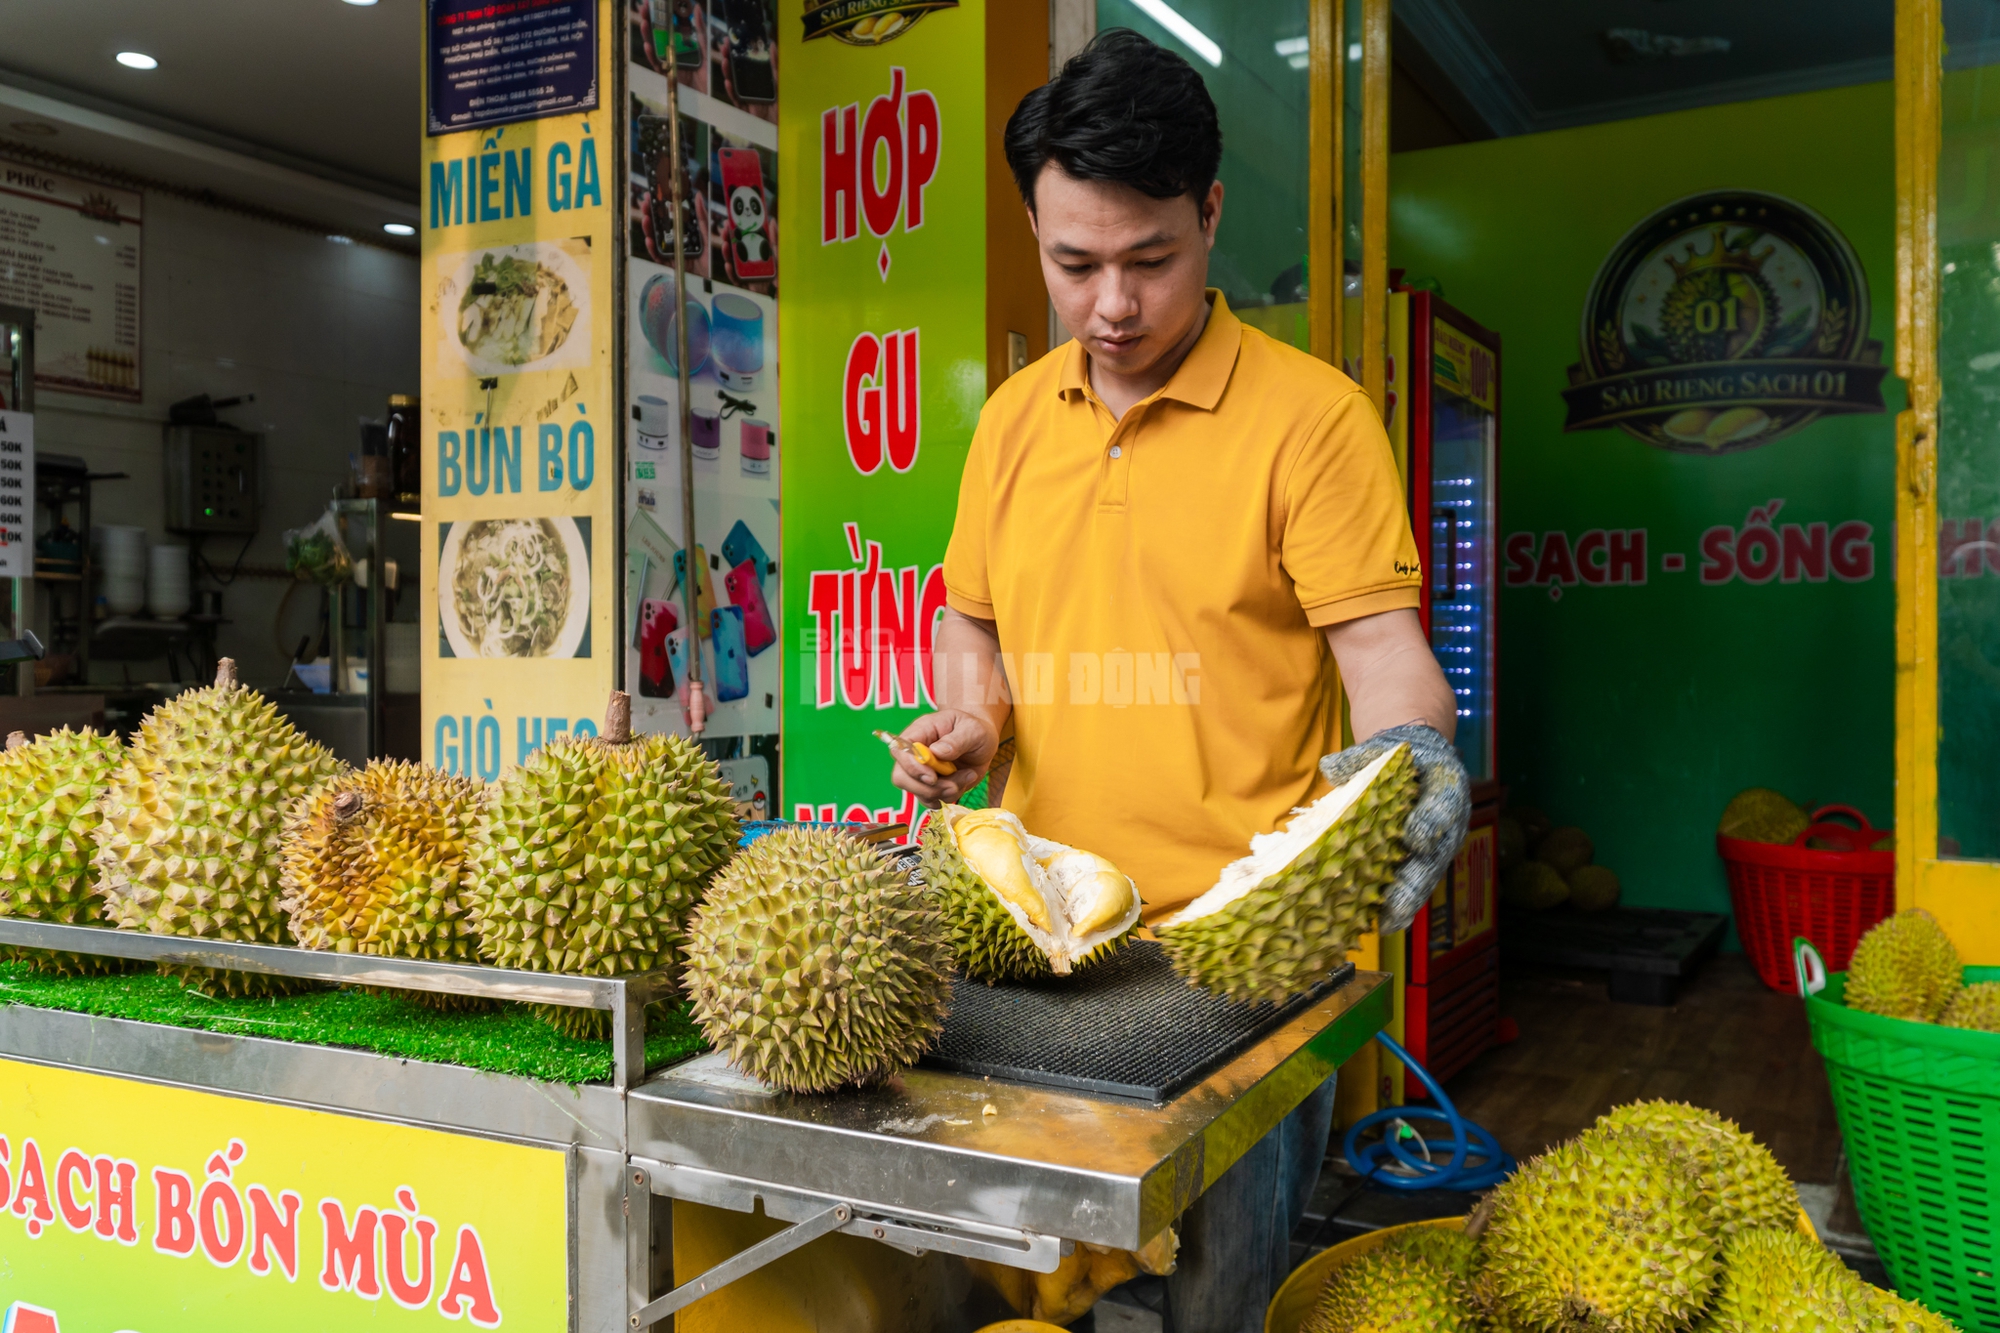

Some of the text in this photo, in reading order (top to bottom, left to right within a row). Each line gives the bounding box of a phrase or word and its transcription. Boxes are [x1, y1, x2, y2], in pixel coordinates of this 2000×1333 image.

[430, 122, 602, 229] MIẾN GÀ
[821, 65, 941, 283] HỢP
[1694, 294, 1739, 335] 01
[843, 326, 920, 476] GU
[1813, 370, 1847, 397] 01
[437, 402, 595, 497] BÚN BÒ
[1505, 527, 1648, 602] SẠCH
[1700, 499, 1875, 585] SỐNG
[433, 698, 502, 785] GIÒ
[152, 1137, 301, 1284] BỐN
[320, 1185, 502, 1329] MÙA
